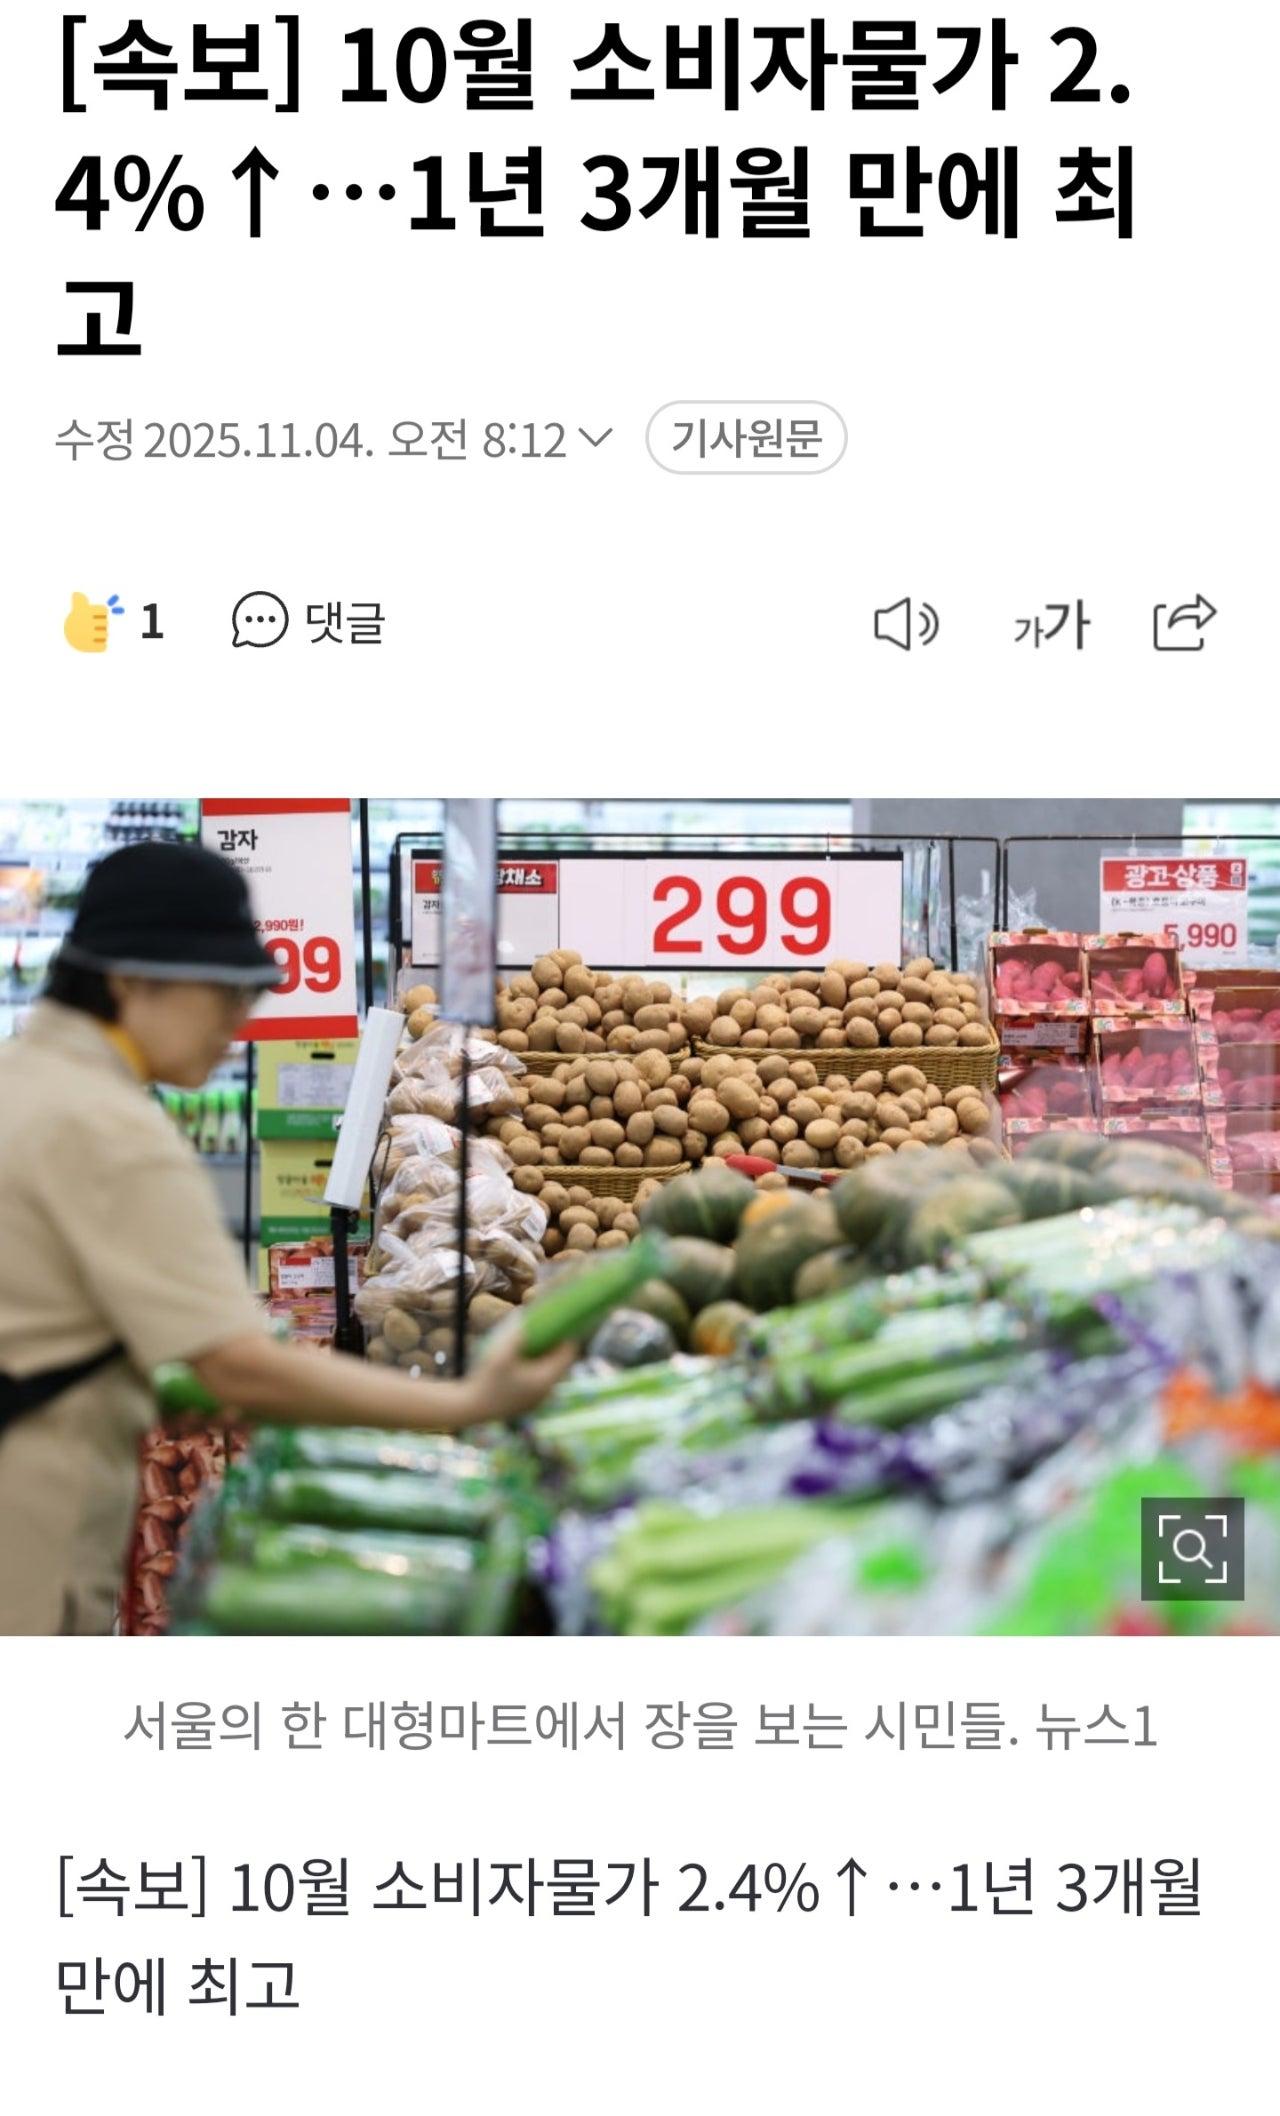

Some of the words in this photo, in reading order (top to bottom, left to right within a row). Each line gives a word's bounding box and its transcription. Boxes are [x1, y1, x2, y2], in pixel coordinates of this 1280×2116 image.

[217, 829, 258, 851] 감자
[652, 875, 831, 956] 299
[1163, 922, 1237, 952] 5,990
